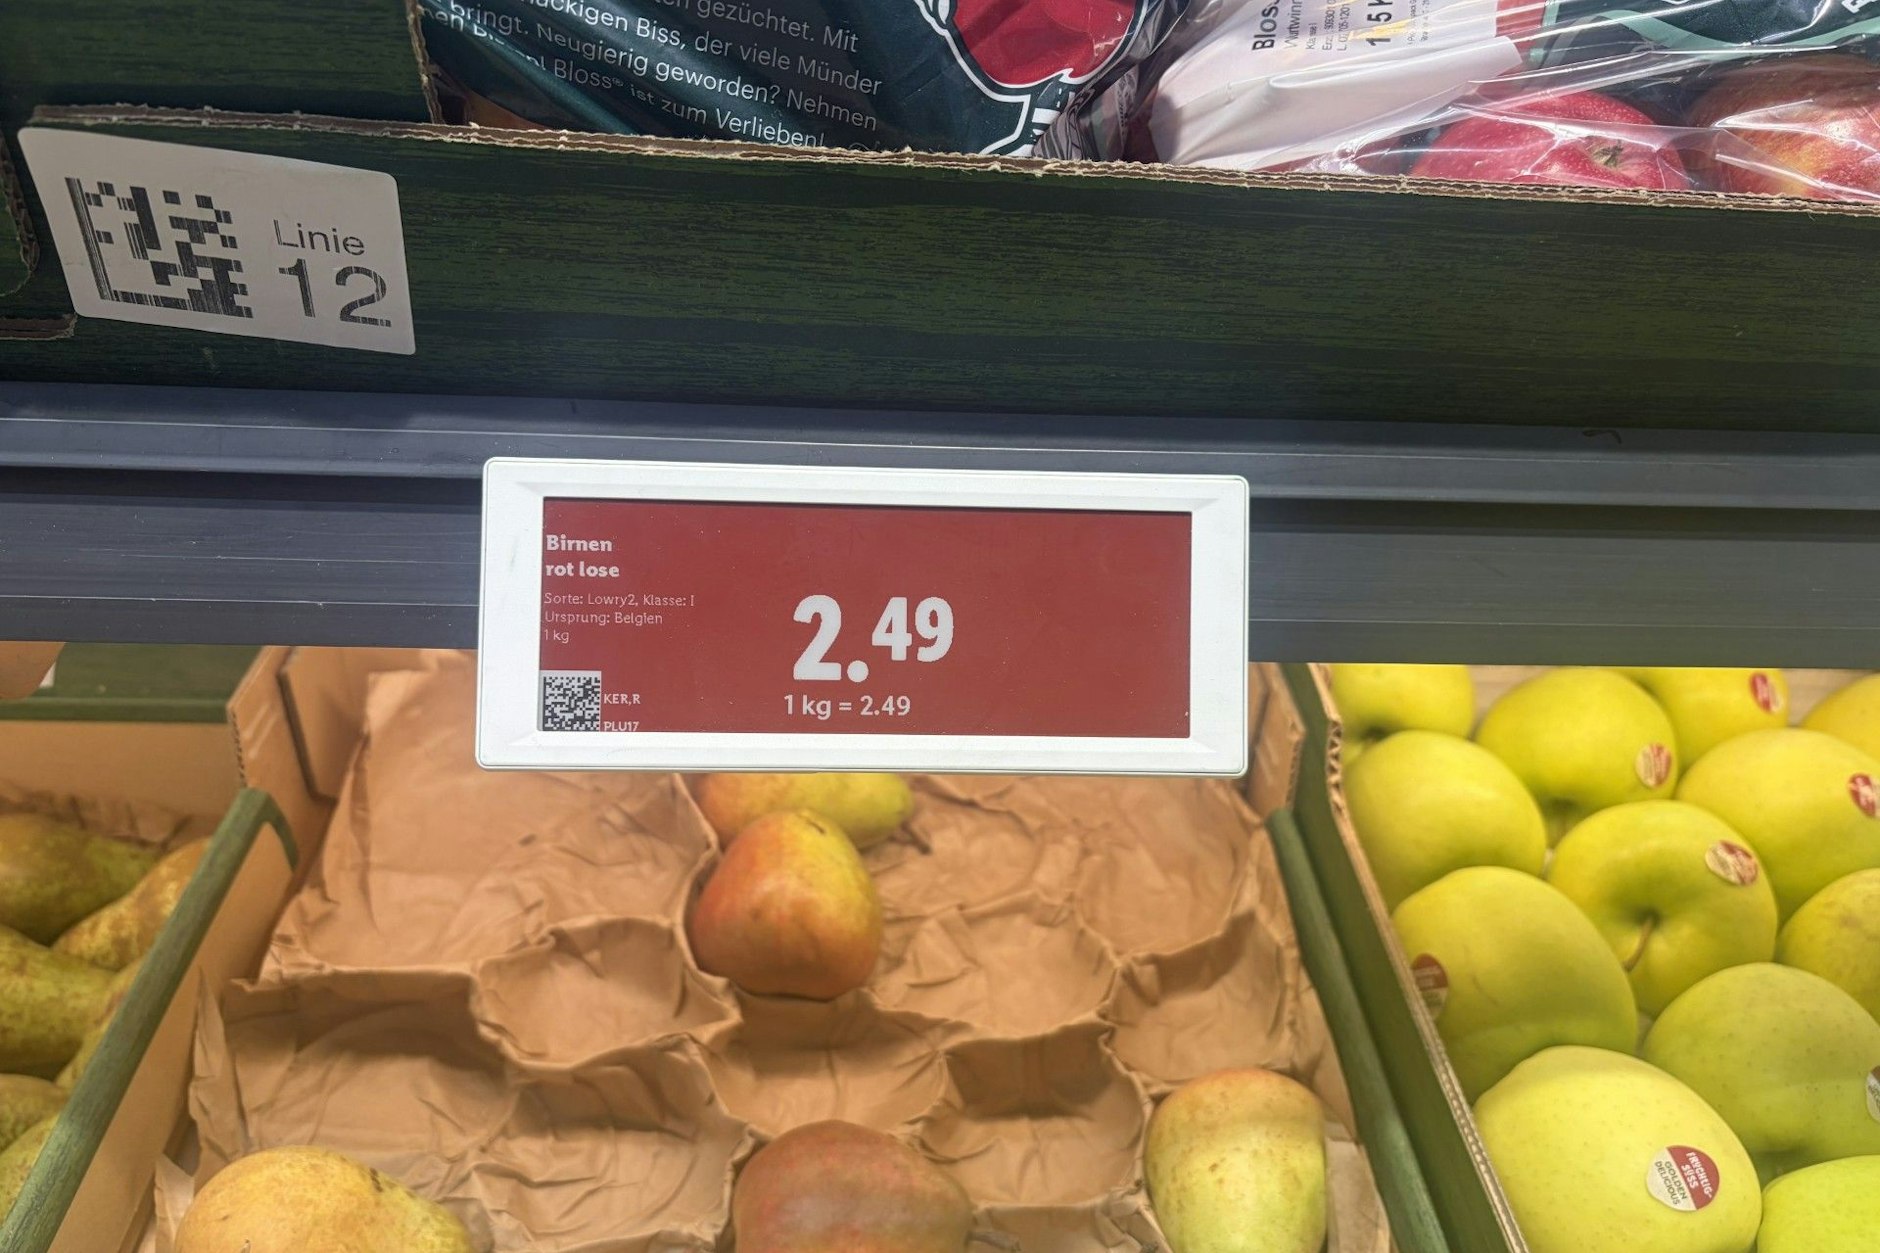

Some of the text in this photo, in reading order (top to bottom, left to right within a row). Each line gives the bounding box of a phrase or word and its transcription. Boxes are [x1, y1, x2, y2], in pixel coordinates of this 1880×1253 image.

[697, 0, 859, 53] gezüchtet. Mit
[450, 1, 529, 36] bringt.
[537, 23, 648, 77] Neugierig
[655, 61, 781, 105] geworden?
[787, 88, 877, 131] Nehmen
[636, 17, 686, 50] Biss,
[694, 31, 733, 57] der
[740, 43, 791, 70] viele
[797, 56, 883, 96] Münder
[630, 84, 656, 106] ist
[661, 99, 707, 125] zum
[273, 219, 365, 256] Linie
[278, 258, 392, 328] 12
[546, 534, 613, 552] Birnen
[545, 561, 620, 578] rot lose
[543, 592, 584, 605] Sorte:
[588, 594, 639, 608] Lowry2,
[643, 594, 687, 607] Klasse:
[545, 611, 663, 627] Ursprung: Belgien
[544, 629, 570, 644] 1 kg
[793, 594, 954, 683] 2.49
[784, 694, 911, 720] 1 kg = 2.49
[603, 721, 640, 732] PLU17
[1654, 1160, 1681, 1205] DELICIOUS
[1664, 1160, 1688, 1200] GOLDEN
